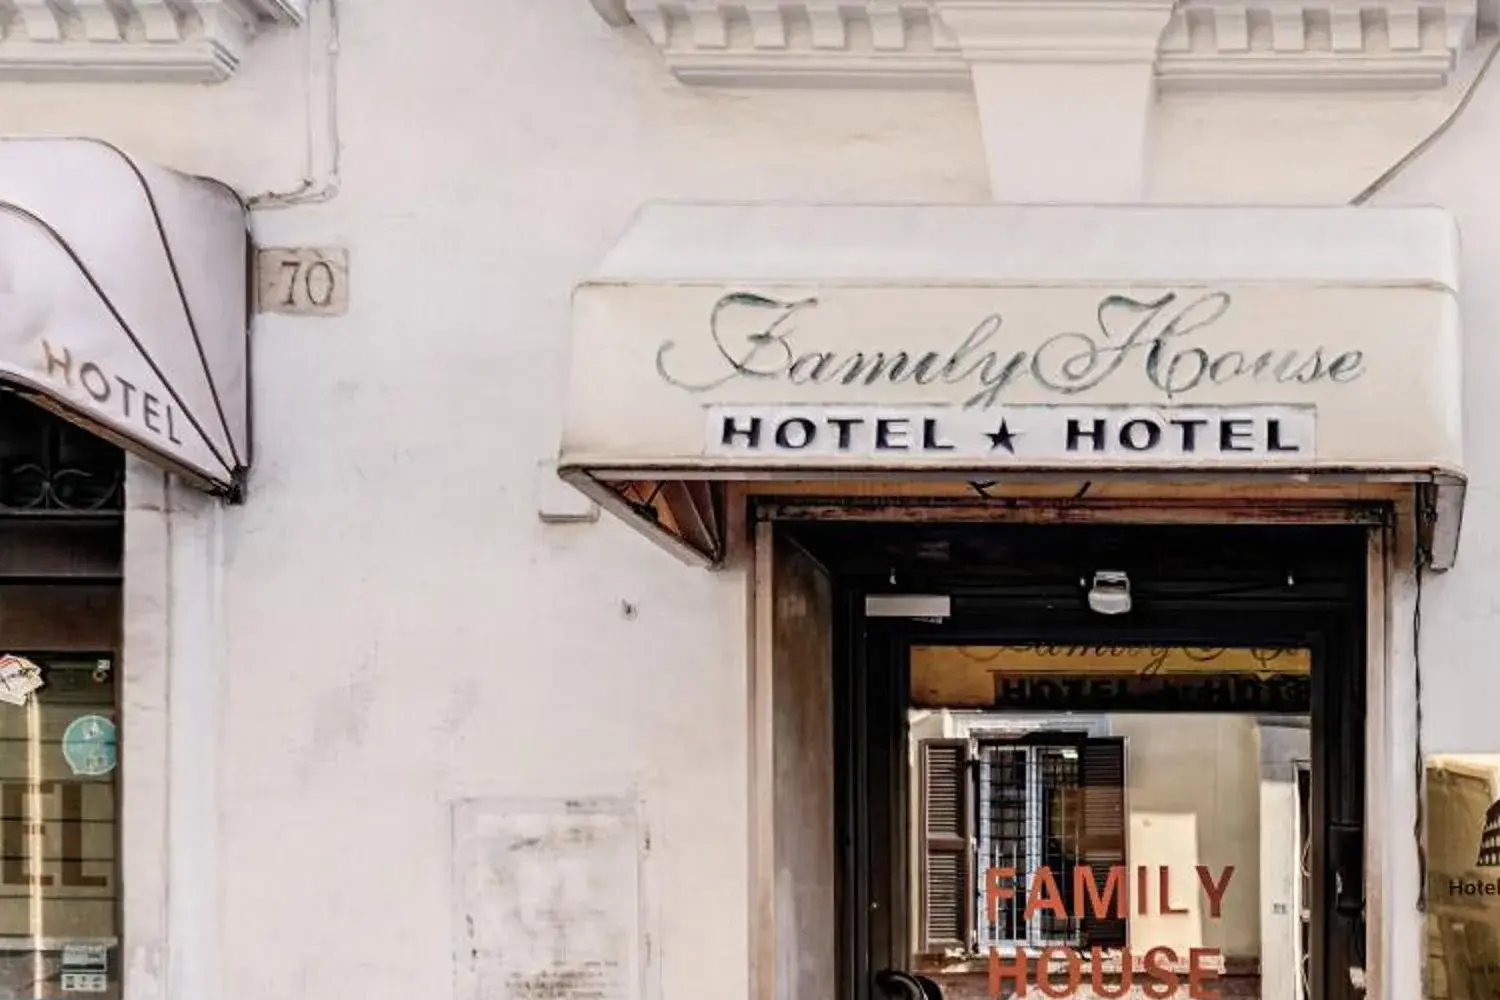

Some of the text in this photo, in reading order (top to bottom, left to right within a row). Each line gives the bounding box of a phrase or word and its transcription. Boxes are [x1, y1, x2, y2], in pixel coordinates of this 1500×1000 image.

[281, 261, 336, 307] 70
[656, 290, 1366, 411] Family House
[42, 338, 183, 446] HOTEL
[720, 416, 1301, 453] HOTEL HOTEL
[986, 864, 1236, 922] FAMILY
[987, 945, 1222, 1000] HOUSE
